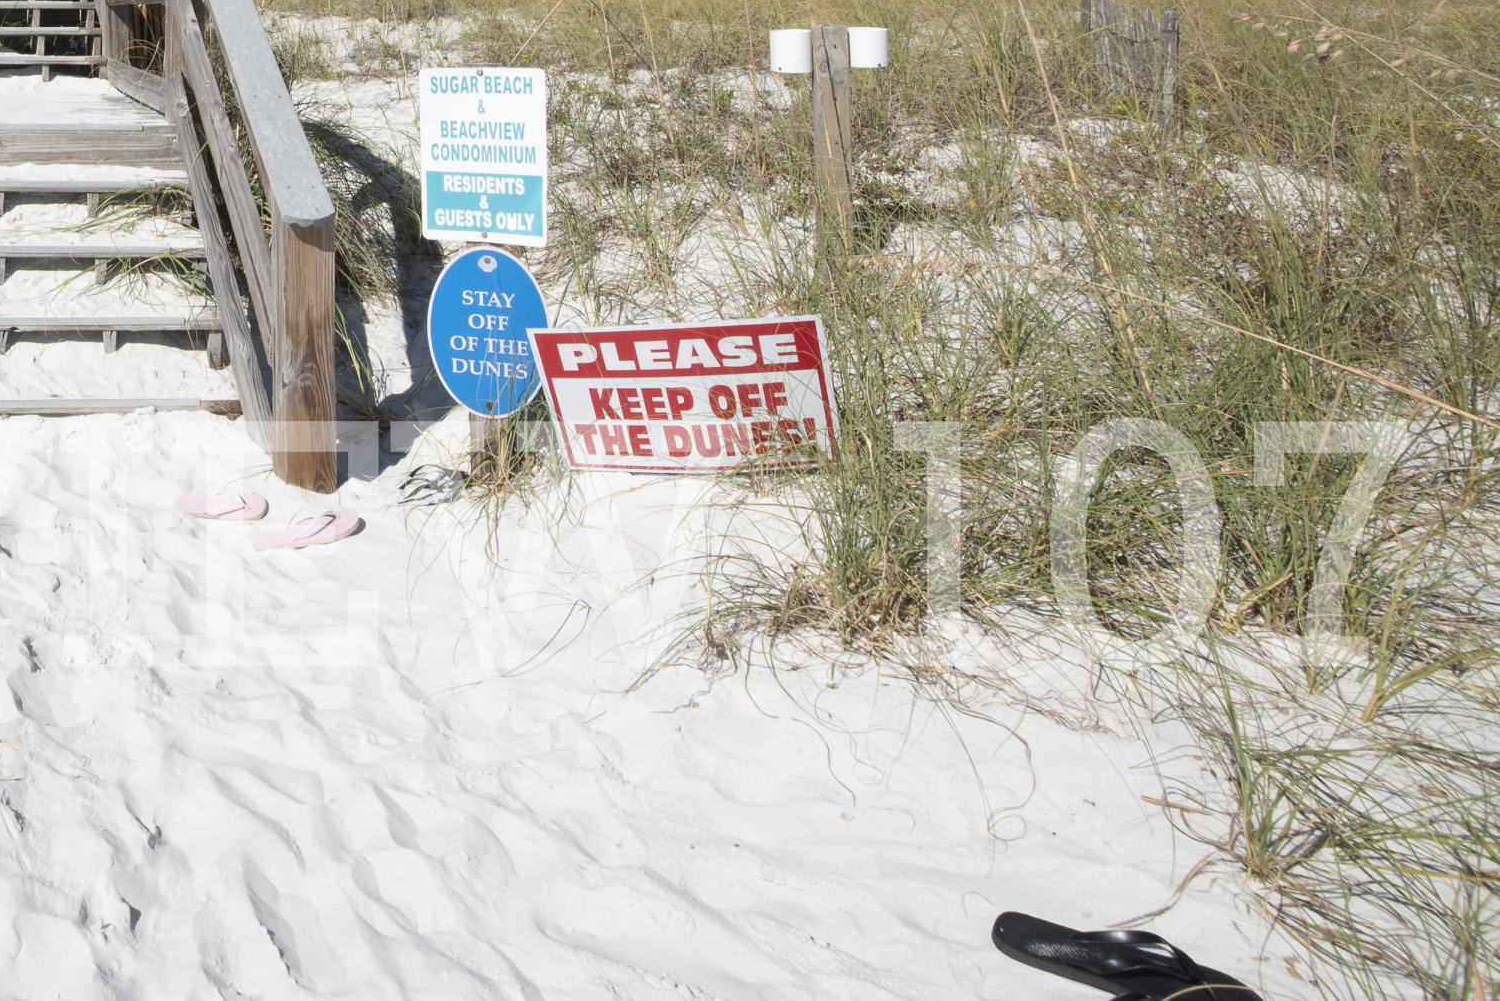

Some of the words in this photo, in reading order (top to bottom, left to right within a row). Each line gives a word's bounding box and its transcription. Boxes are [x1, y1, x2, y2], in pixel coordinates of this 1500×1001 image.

[430, 75, 479, 94] SUGAR
[484, 76, 533, 95] BEACH
[477, 99, 485, 114] &
[440, 120, 526, 140] BEACHVIEW
[430, 143, 537, 164] CONDOMINIUM
[443, 174, 526, 195] RESIDENTS
[479, 195, 490, 210] &
[434, 208, 493, 229] GUESTS
[495, 212, 536, 232] ONLY
[461, 289, 516, 309] STAY
[468, 313, 509, 331] OFF
[449, 335, 479, 352] OF
[483, 337, 529, 357] THE
[556, 333, 800, 372] PLEASE
[451, 357, 529, 380] DUNES
[588, 386, 695, 421] KEEP
[708, 381, 789, 420] OFF
[574, 423, 654, 457] THE
[662, 417, 819, 459] DUNES!
